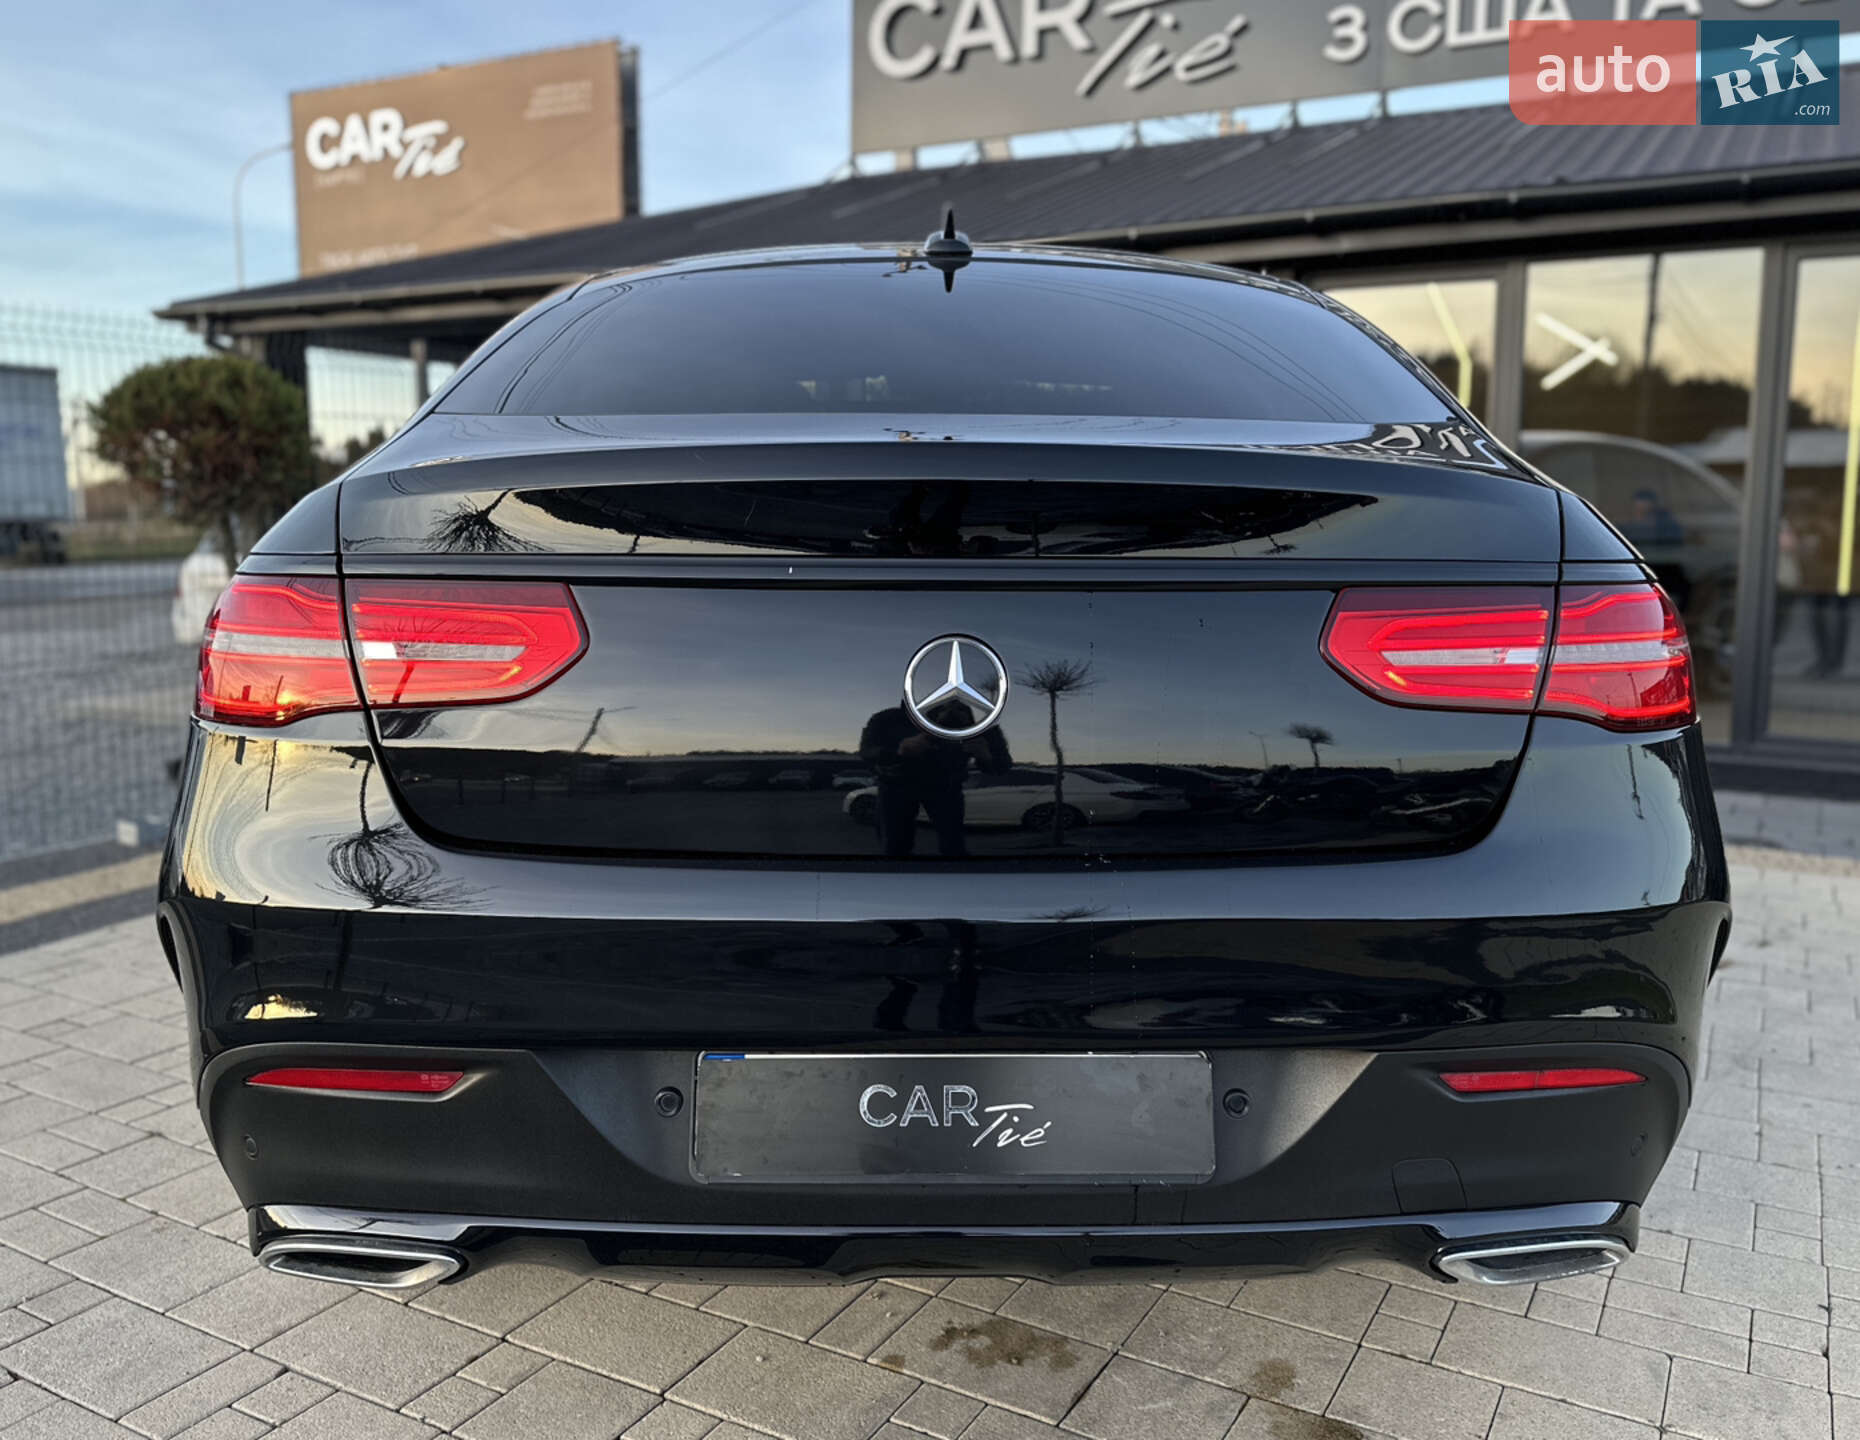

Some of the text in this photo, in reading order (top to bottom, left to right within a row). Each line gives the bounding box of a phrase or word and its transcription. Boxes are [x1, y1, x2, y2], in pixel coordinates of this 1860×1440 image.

[867, 0, 1093, 79] CAR
[305, 107, 404, 171] CAR
[859, 1083, 1053, 1149] CAR Tié
